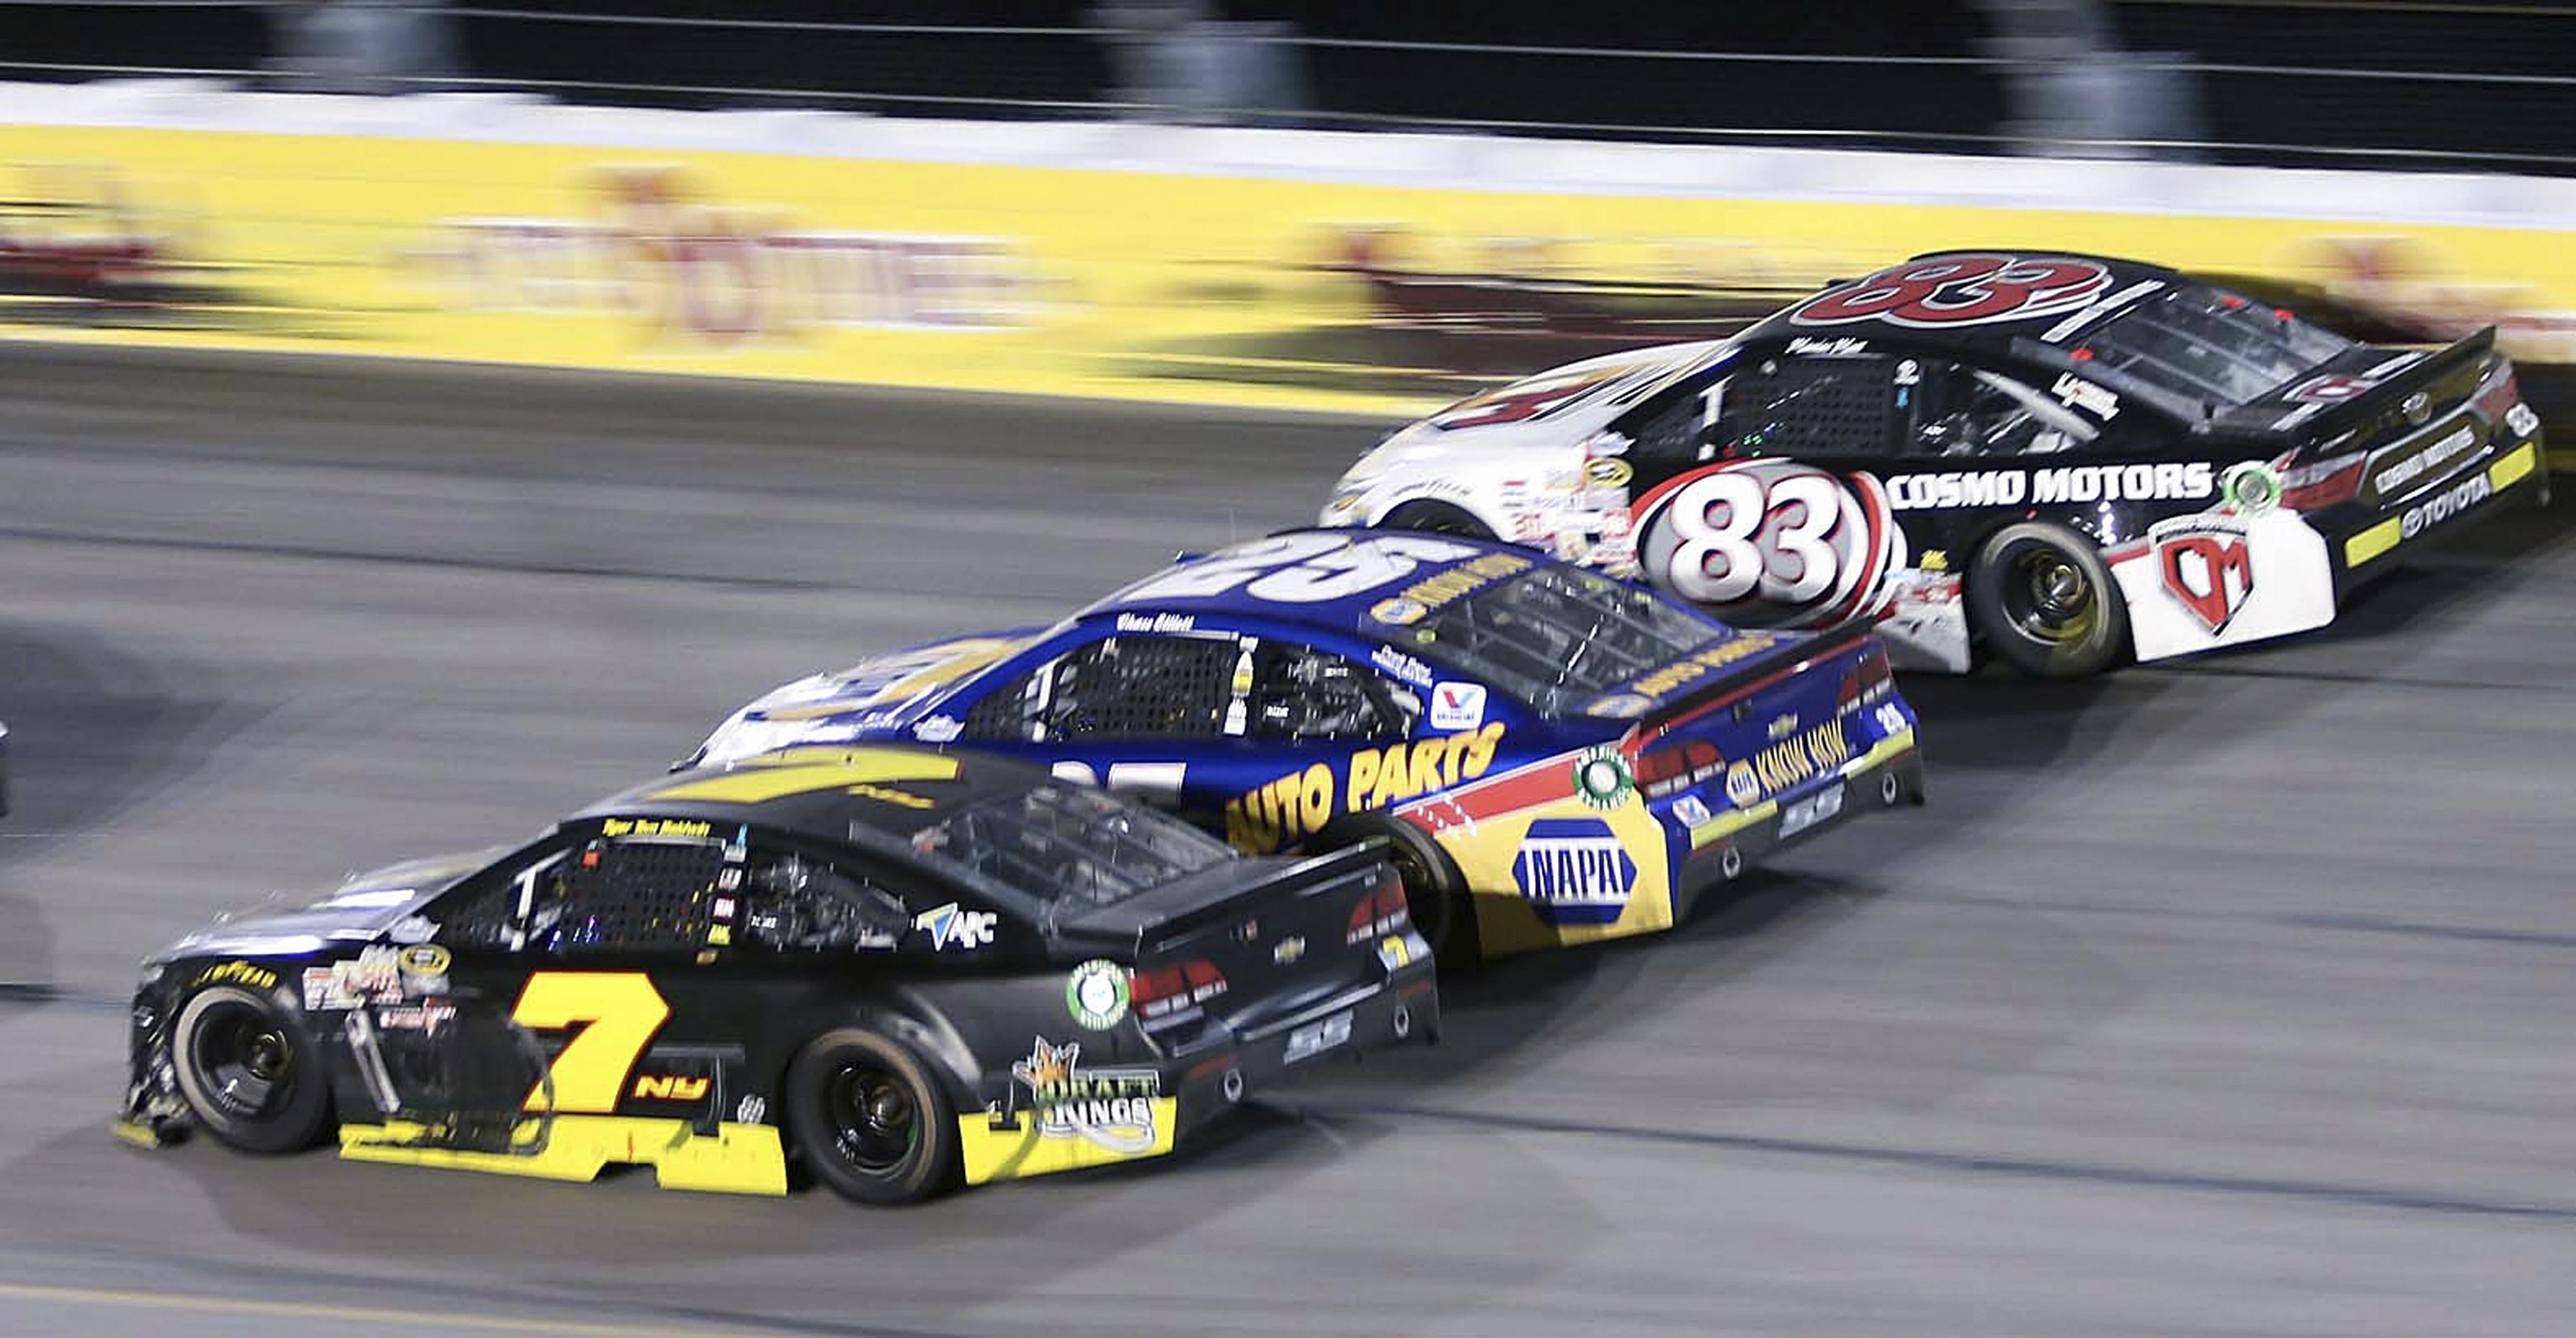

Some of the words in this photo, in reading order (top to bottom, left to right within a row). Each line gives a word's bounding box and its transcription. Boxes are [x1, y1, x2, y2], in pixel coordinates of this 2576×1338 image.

[1789, 253, 2111, 328] 83
[1885, 470, 2026, 509] COSMO
[2032, 462, 2213, 505] MOTORS
[2422, 472, 2493, 528] TOYOTA
[1670, 472, 1840, 604] 83
[1227, 762, 1334, 855] AUTO
[1347, 721, 1506, 813] PARTS
[1756, 734, 1813, 798] KNOW
[1807, 713, 1848, 776] HOW
[1522, 843, 1632, 901] NAPA
[1383, 935, 1410, 968] 7
[508, 967, 674, 1115] 7
